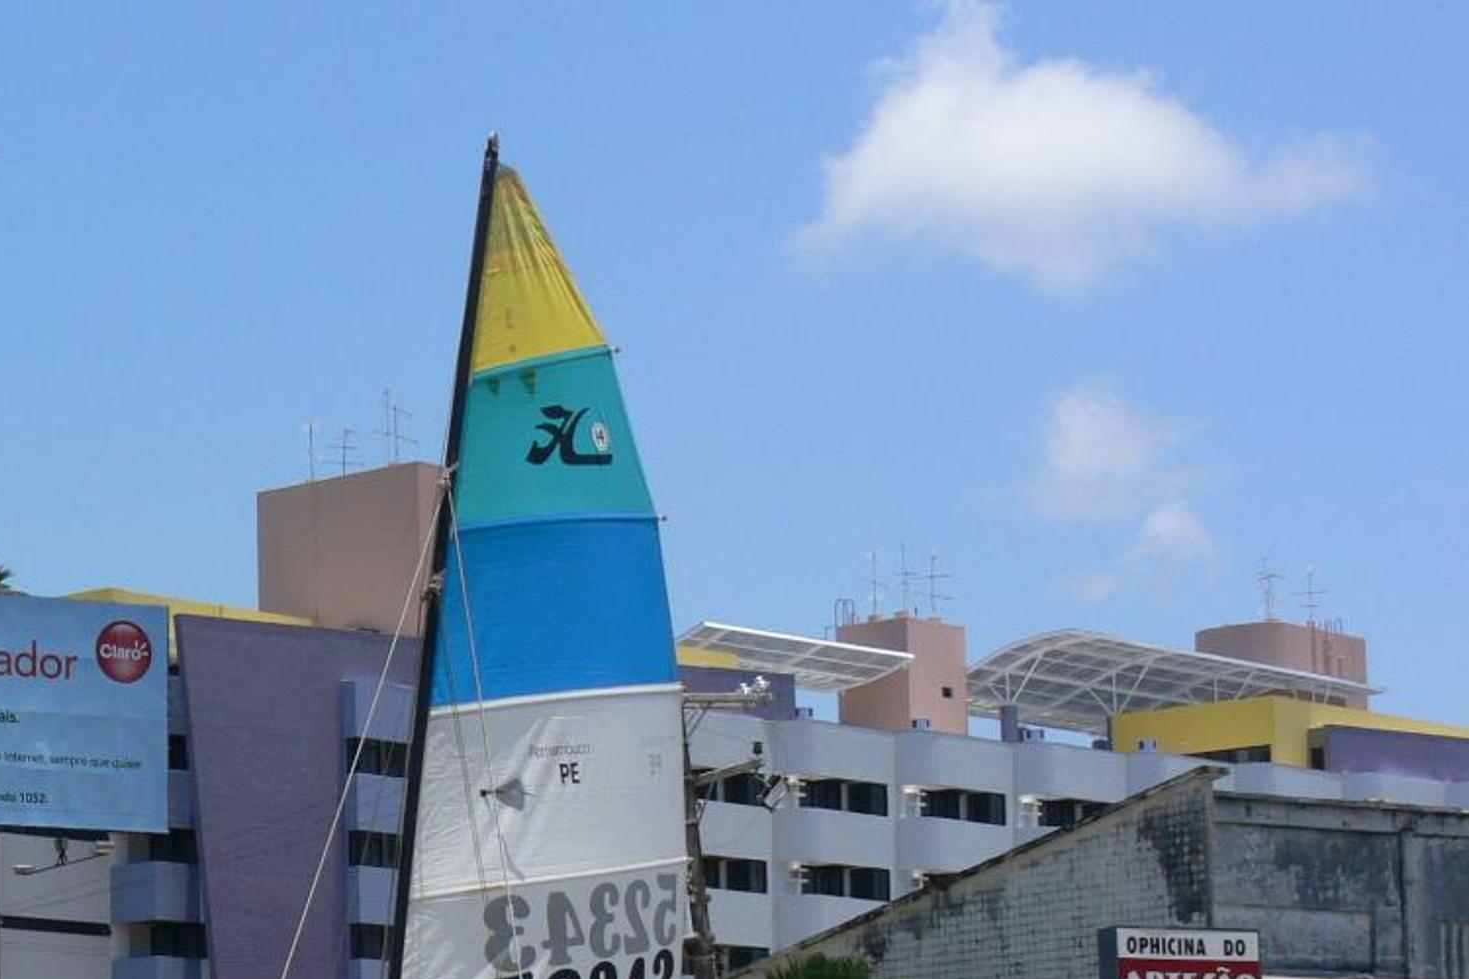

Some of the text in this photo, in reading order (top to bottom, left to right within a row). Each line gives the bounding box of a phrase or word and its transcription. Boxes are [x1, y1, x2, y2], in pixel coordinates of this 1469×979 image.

[99, 643, 141, 660] Claro
[559, 762, 581, 784] PE
[1126, 936, 1247, 956] OPHICINA DO
